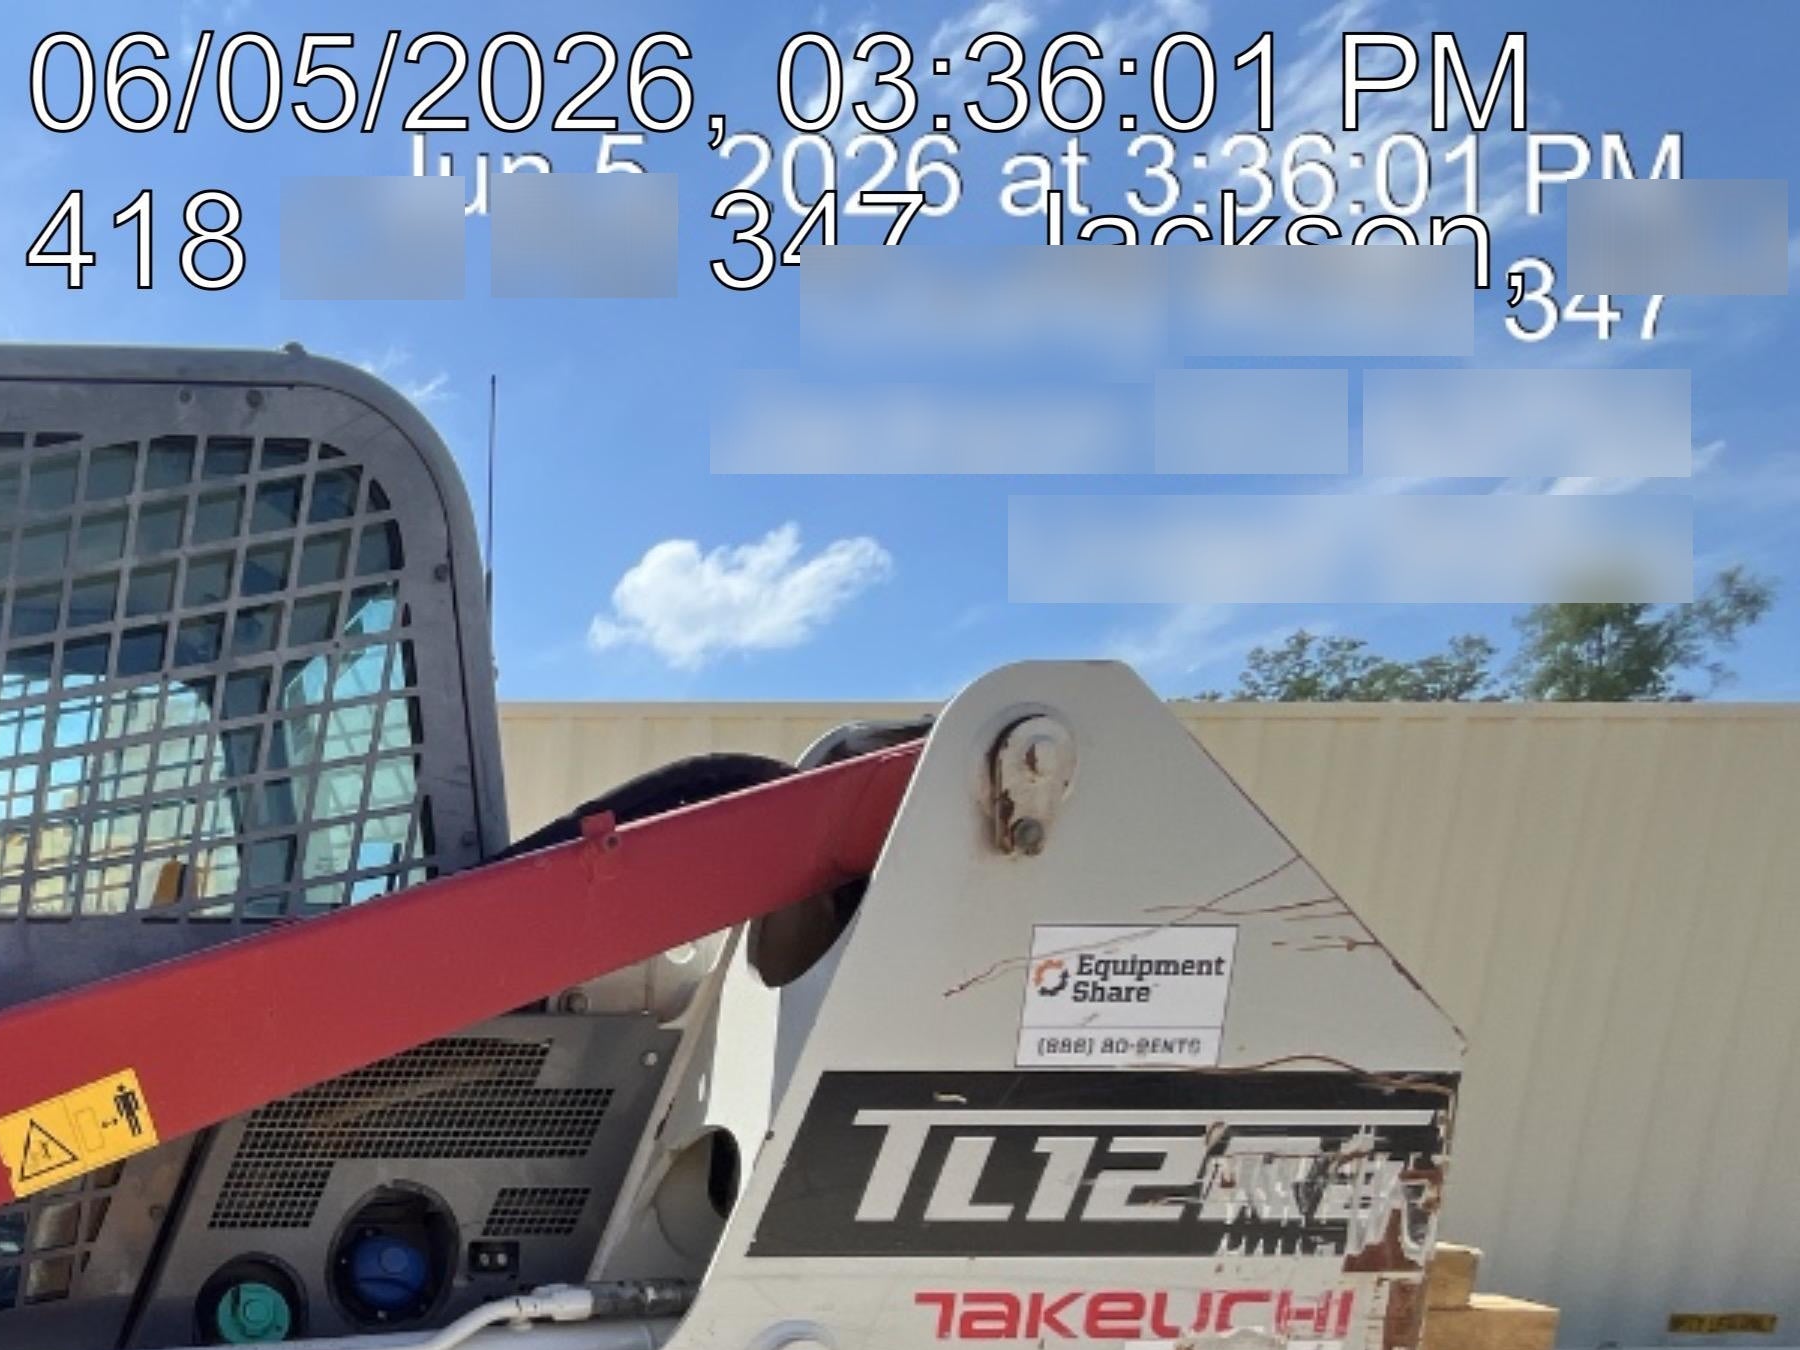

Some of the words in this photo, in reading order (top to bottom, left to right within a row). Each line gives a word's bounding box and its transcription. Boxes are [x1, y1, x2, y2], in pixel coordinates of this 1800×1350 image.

[1076, 954, 1226, 981] Equipment
[1072, 981, 1151, 1002] Share
[1037, 1037, 1094, 1056] (888)
